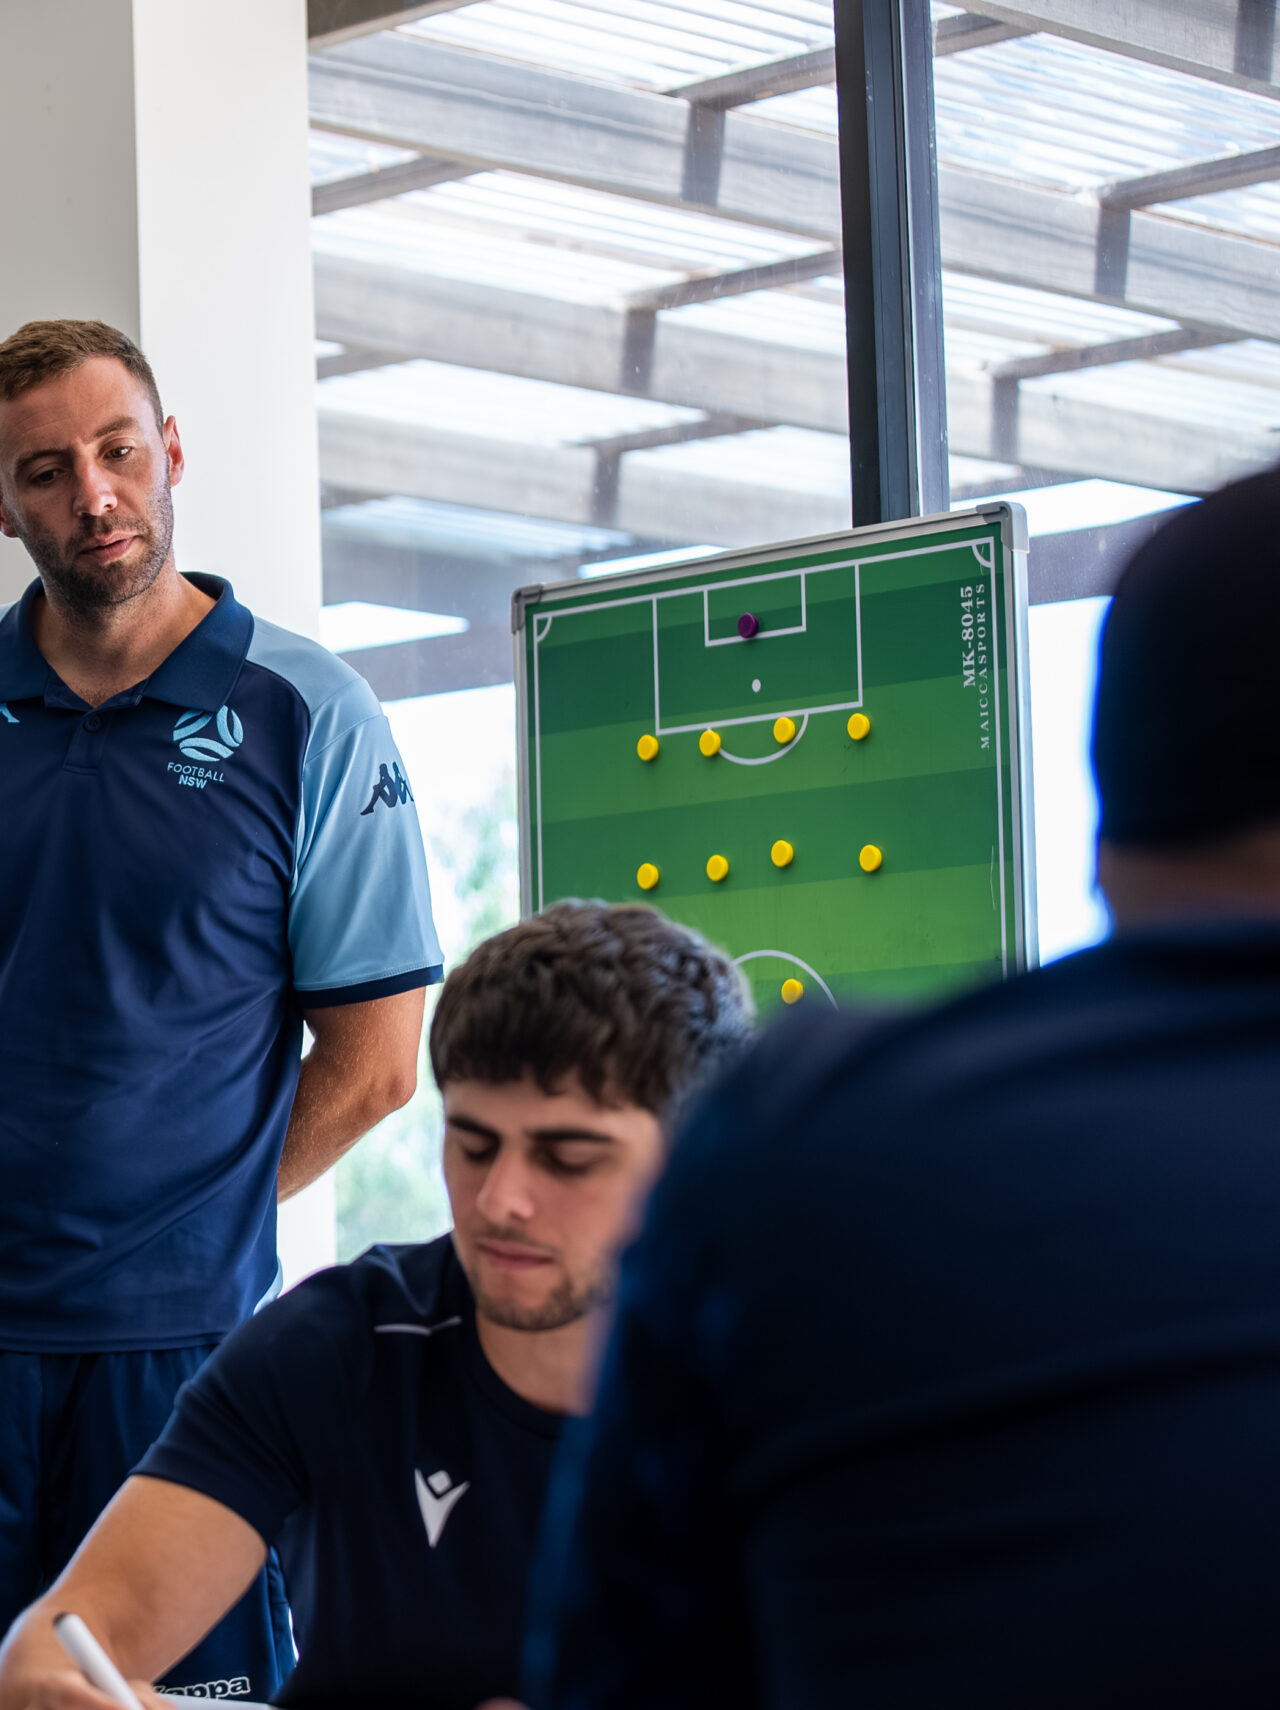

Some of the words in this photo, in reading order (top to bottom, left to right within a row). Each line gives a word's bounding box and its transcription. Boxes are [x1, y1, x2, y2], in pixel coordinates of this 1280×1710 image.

[960, 586, 975, 688] MK-8045
[976, 583, 990, 749] MAICCASPORTS
[167, 762, 225, 783] FOOTBALL
[178, 774, 207, 789] NSW
